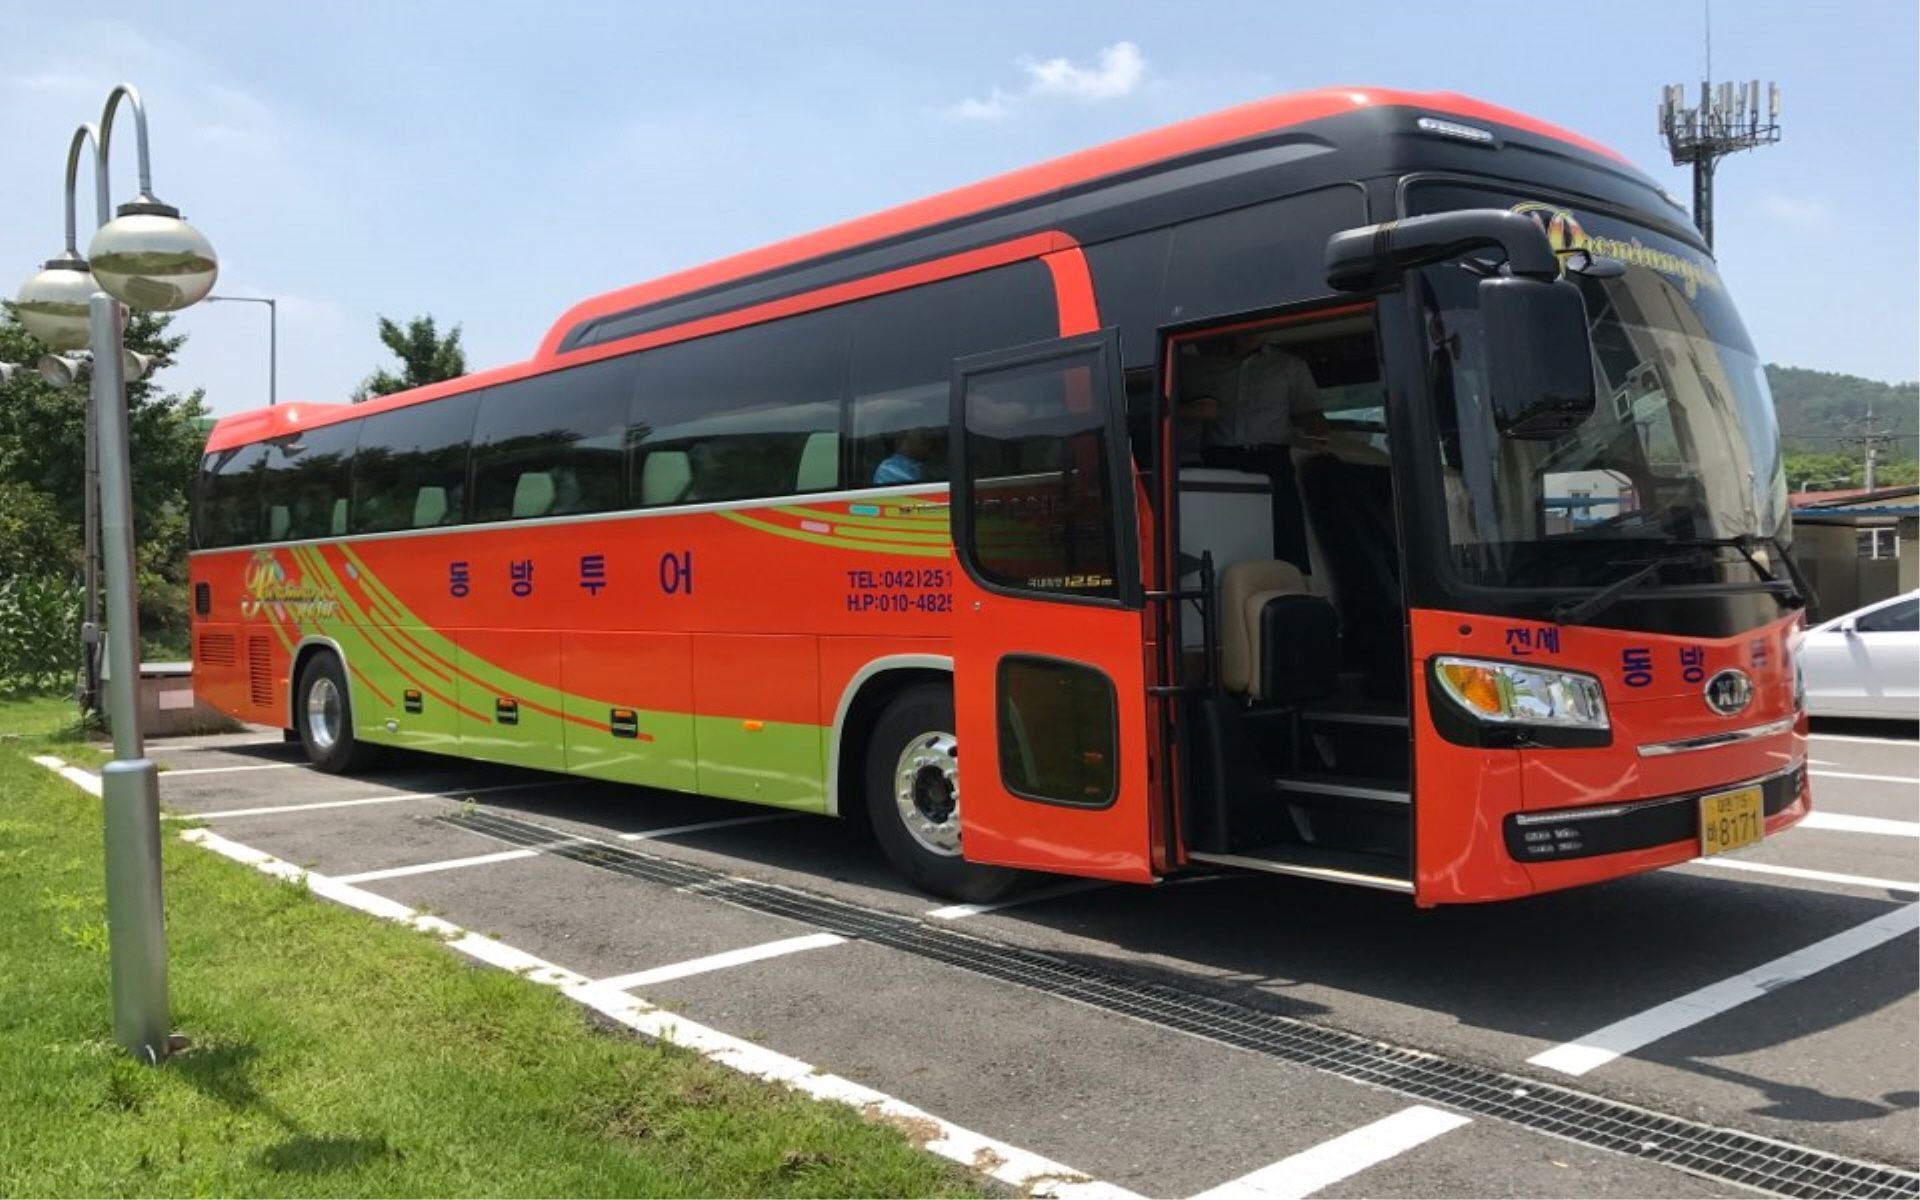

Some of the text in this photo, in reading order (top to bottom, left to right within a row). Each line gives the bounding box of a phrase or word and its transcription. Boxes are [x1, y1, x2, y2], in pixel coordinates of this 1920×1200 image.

[449, 550, 693, 598] 동방투어
[1505, 627, 1561, 656] 전세
[1719, 810, 1759, 847] 8171
